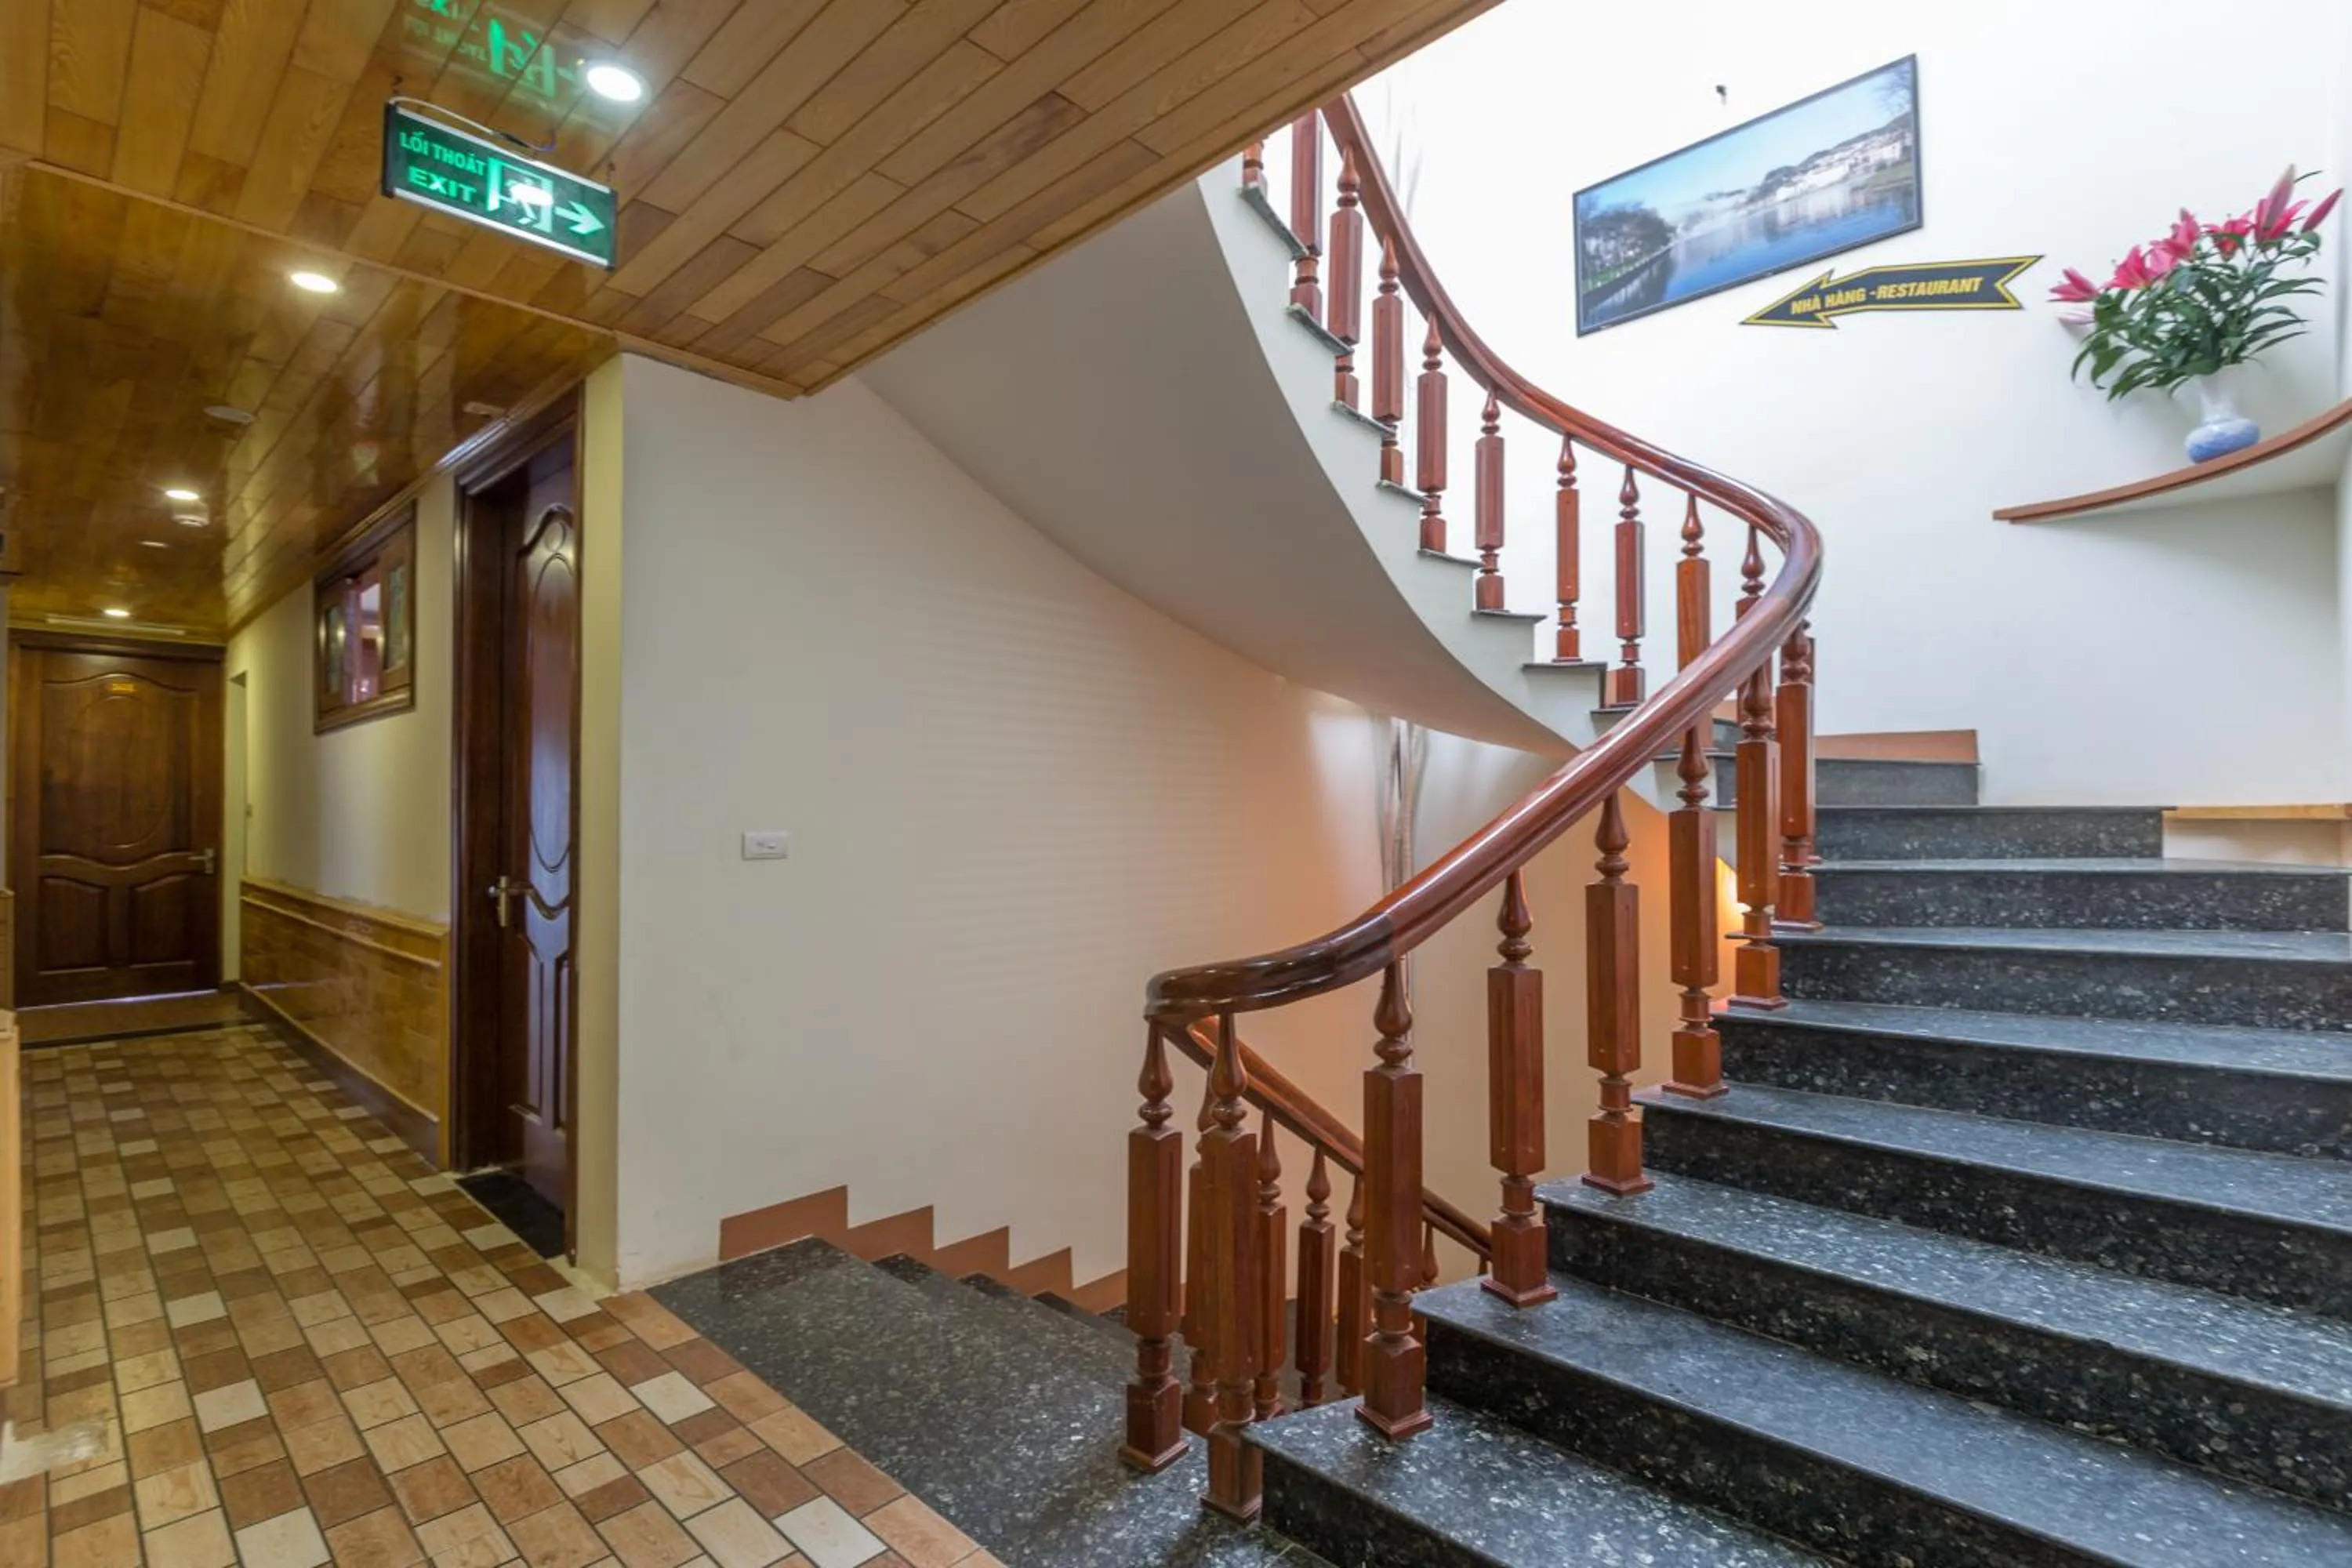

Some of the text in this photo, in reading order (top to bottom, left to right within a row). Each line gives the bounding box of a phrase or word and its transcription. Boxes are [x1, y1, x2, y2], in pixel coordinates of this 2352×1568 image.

[399, 131, 487, 176] LỐI THOÁT
[408, 166, 477, 202] EXIT
[1791, 293, 1821, 315] NHÀ
